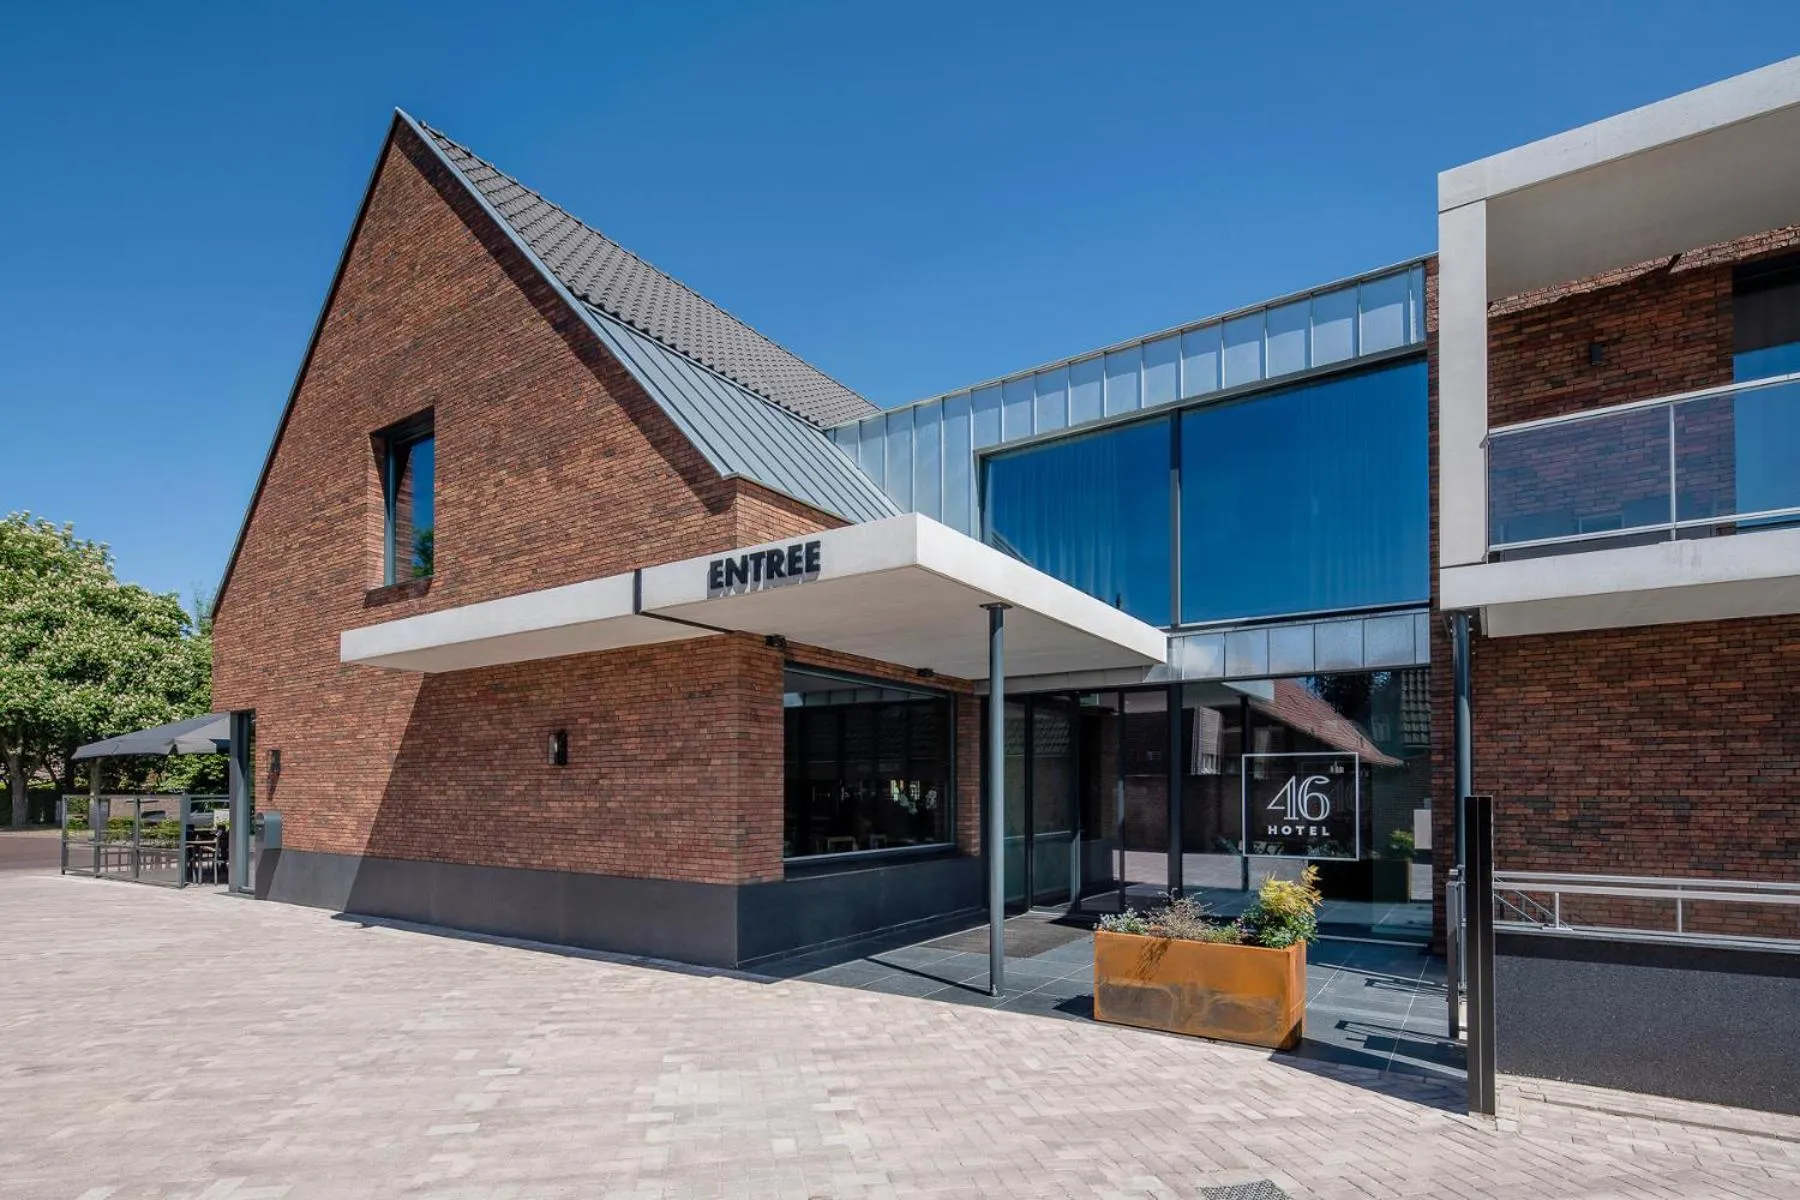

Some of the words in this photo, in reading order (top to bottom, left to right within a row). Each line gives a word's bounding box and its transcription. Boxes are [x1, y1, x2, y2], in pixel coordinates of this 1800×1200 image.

[709, 540, 821, 590] ENTREE
[1266, 775, 1330, 821] 46
[1267, 825, 1330, 836] HOTEL
